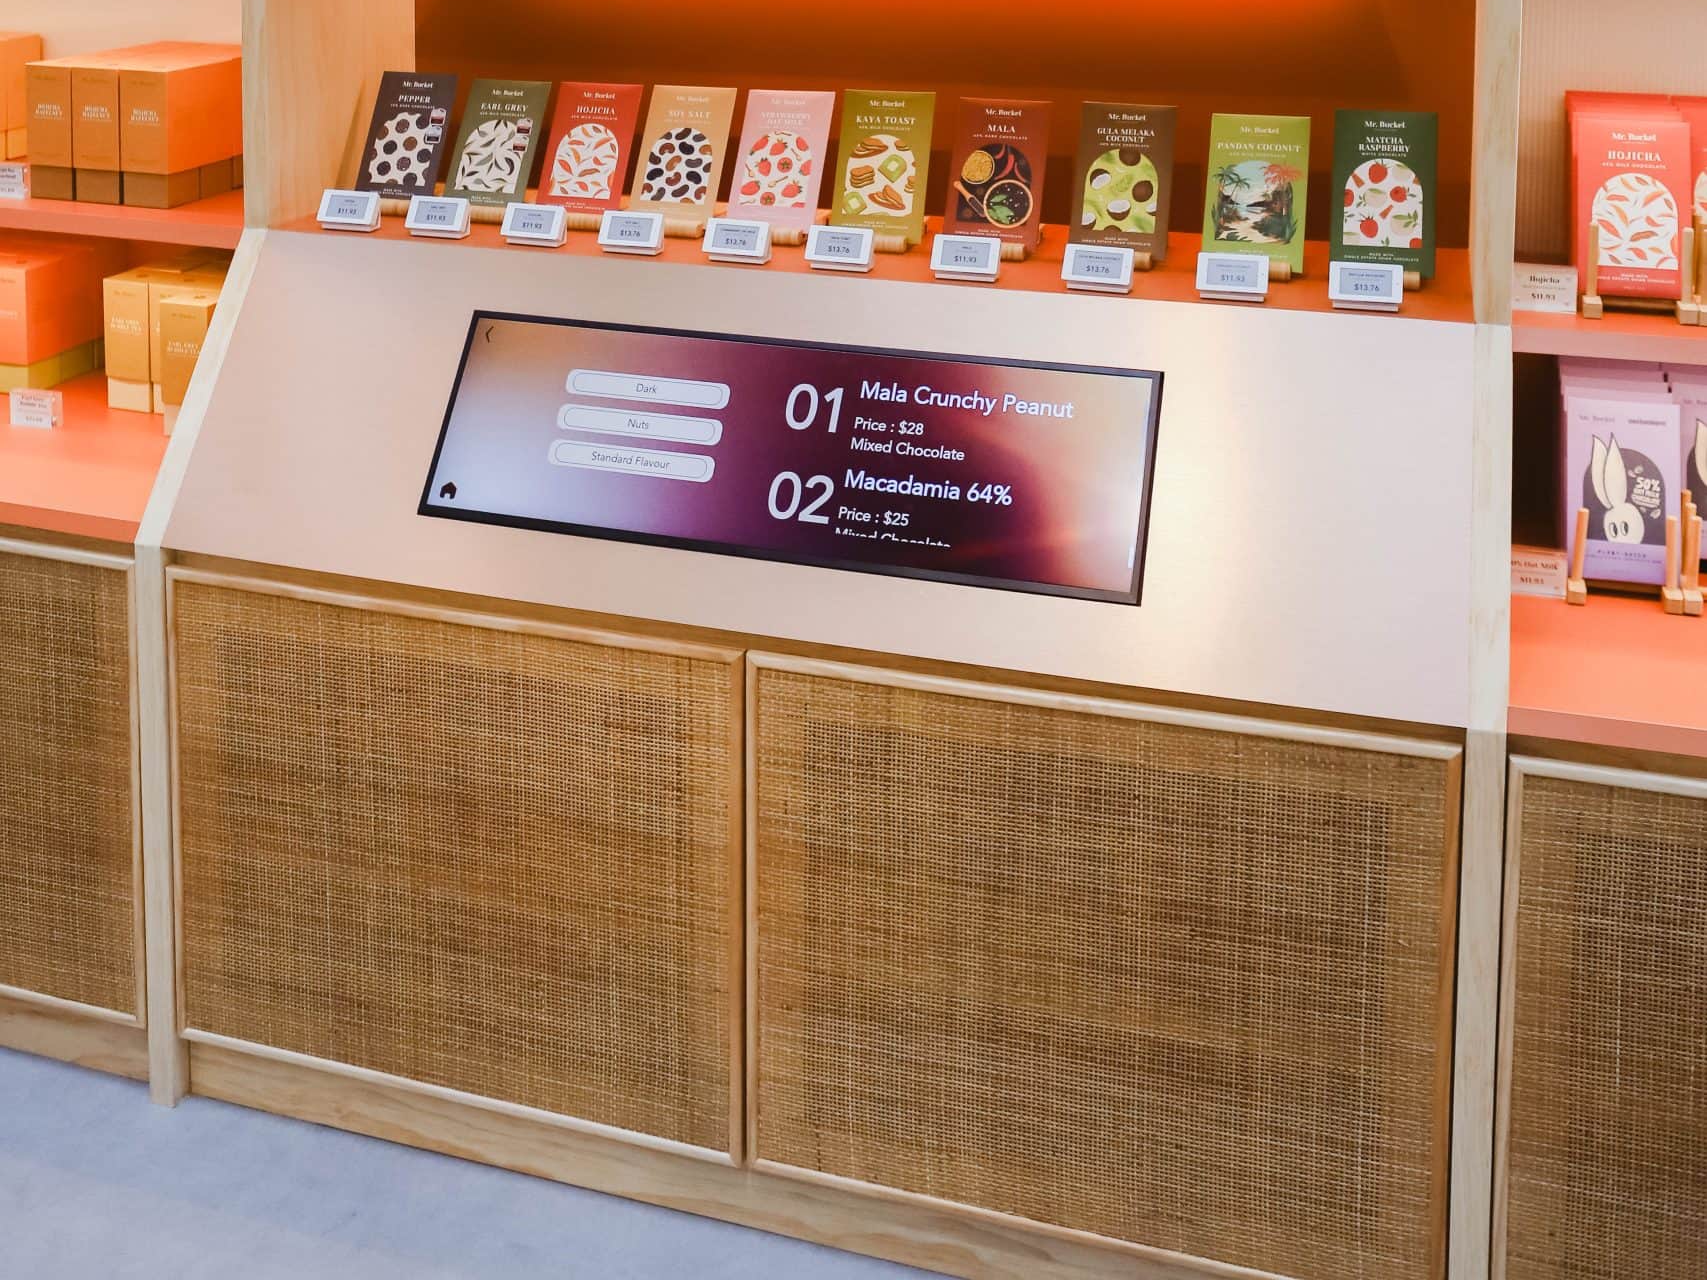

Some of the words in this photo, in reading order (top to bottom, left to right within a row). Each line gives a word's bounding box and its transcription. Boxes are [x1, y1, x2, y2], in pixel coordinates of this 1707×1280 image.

[398, 94, 431, 104] PEPPER
[480, 102, 502, 110] EARL
[504, 104, 528, 112] GREY
[576, 106, 616, 115] HOJICHA
[668, 110, 686, 118] SOY
[689, 111, 712, 120] SALT
[856, 116, 880, 124] KAYA
[884, 116, 916, 125] TOAST
[987, 124, 1016, 134] MALA
[1097, 128, 1120, 136] GULA
[1120, 128, 1155, 137] MELAKA
[1106, 134, 1144, 144] COCONUT
[1366, 136, 1404, 144] MATCHA
[1218, 141, 1255, 151] PANDAN
[1256, 142, 1301, 153] COCONUT
[1358, 143, 1410, 153] RASPBERRY
[1608, 150, 1662, 162] HOJICHA
[620, 229, 641, 238] $13.76
[726, 238, 746, 246] $13.76
[828, 245, 850, 254] $13.76
[1086, 264, 1110, 274] $13.76
[1530, 275, 1560, 284] Hojicha
[1354, 283, 1380, 292] $13.76
[636, 383, 657, 394] Dark
[860, 380, 908, 403] Mala
[914, 386, 996, 416] Crunchy
[1002, 393, 1074, 419] Peanut
[786, 383, 844, 433] 01
[628, 418, 649, 430] Nuts
[854, 416, 887, 432] Price
[898, 420, 924, 436] $28
[850, 437, 892, 454] Mixed
[896, 442, 965, 461] Chocolate
[592, 451, 633, 466] Standard
[844, 469, 960, 501] Macadamia
[966, 483, 1013, 506] 64%
[1636, 476, 1660, 492] 50%
[768, 470, 834, 525] 02
[838, 506, 872, 522] Price
[883, 510, 910, 526] $25
